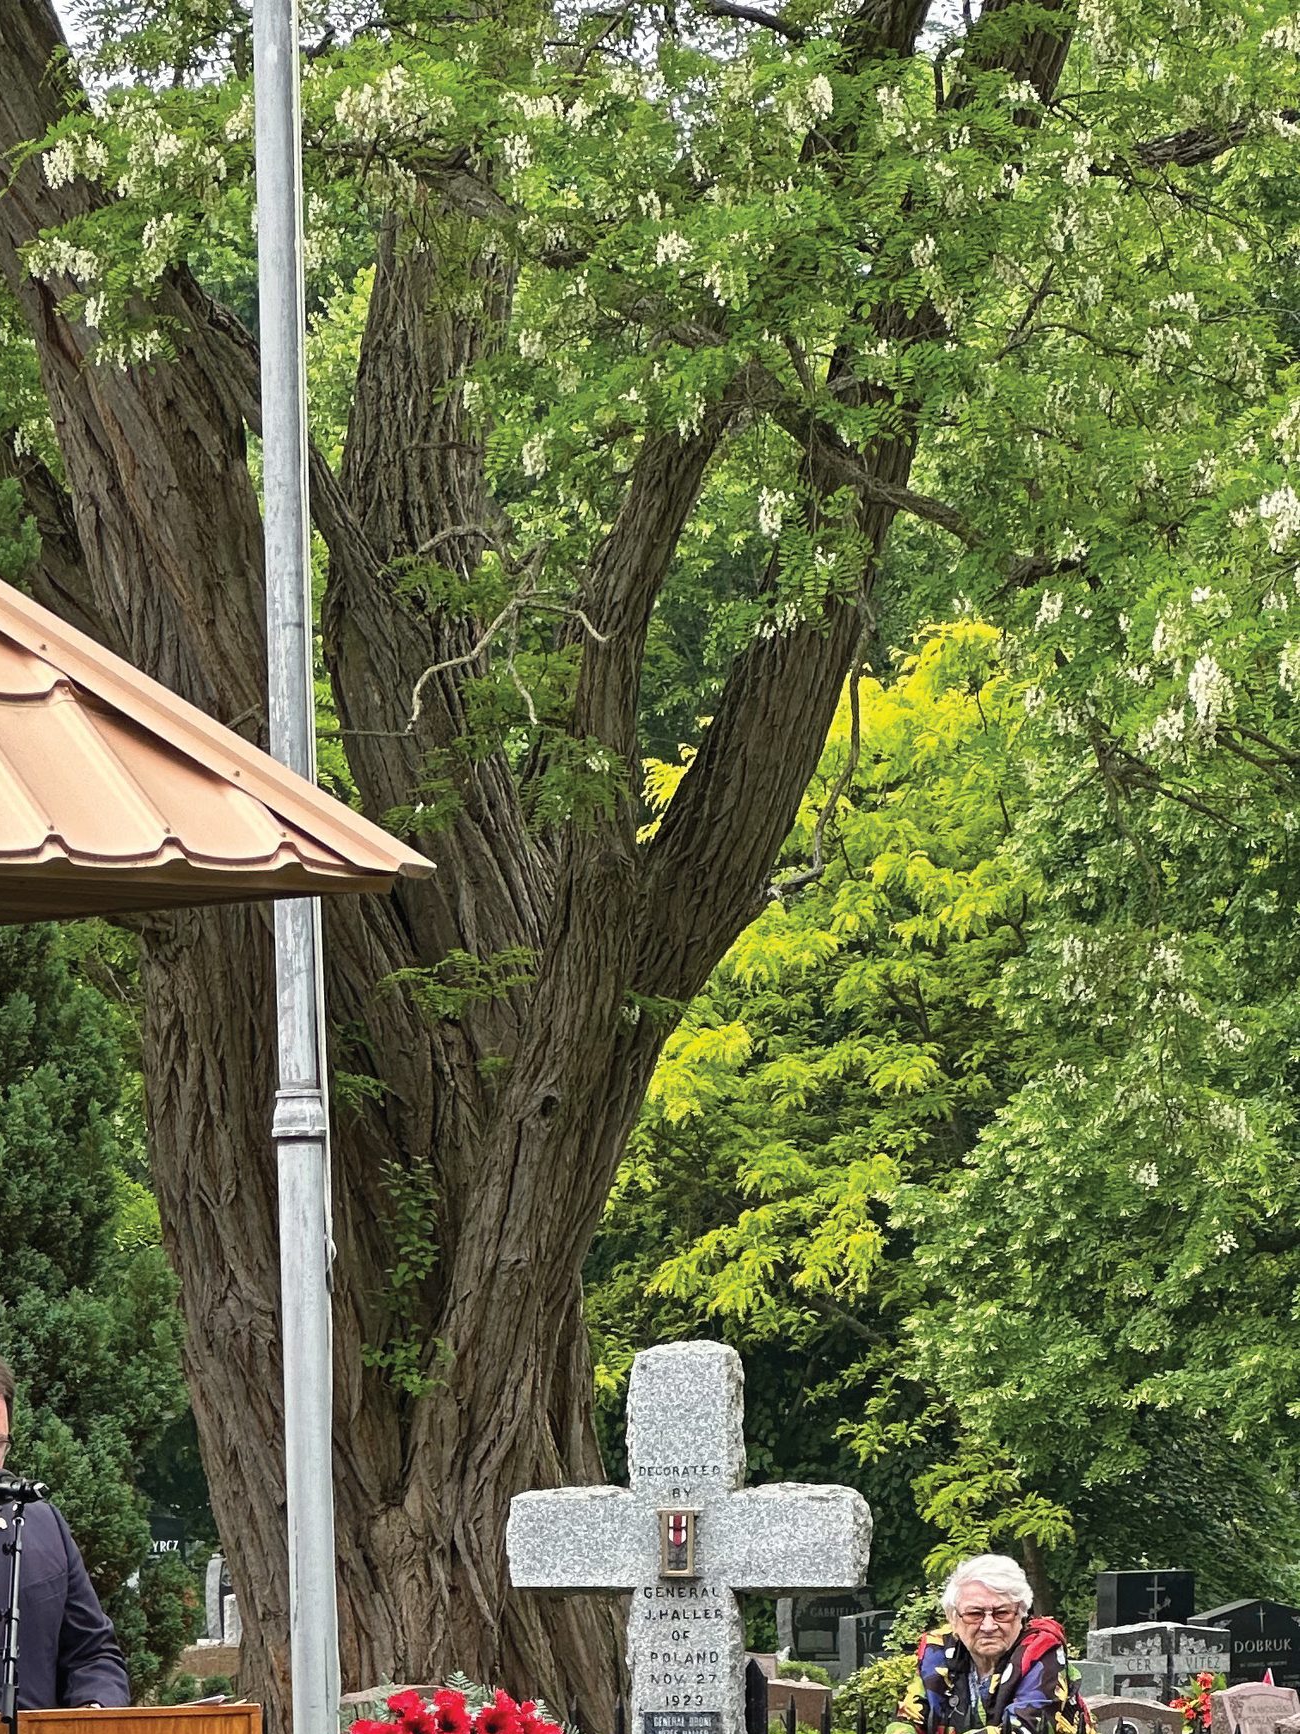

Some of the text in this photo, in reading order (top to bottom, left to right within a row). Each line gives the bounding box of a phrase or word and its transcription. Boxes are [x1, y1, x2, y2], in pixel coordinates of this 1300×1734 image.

[638, 1465, 721, 1477] DECORATED
[671, 1487, 692, 1498] BY
[643, 1586, 720, 1599] GENERAL
[671, 1630, 691, 1642] OF
[1234, 1638, 1293, 1654] DOBRUK
[650, 1651, 720, 1664] POLAND
[664, 1695, 704, 1707] 1923
